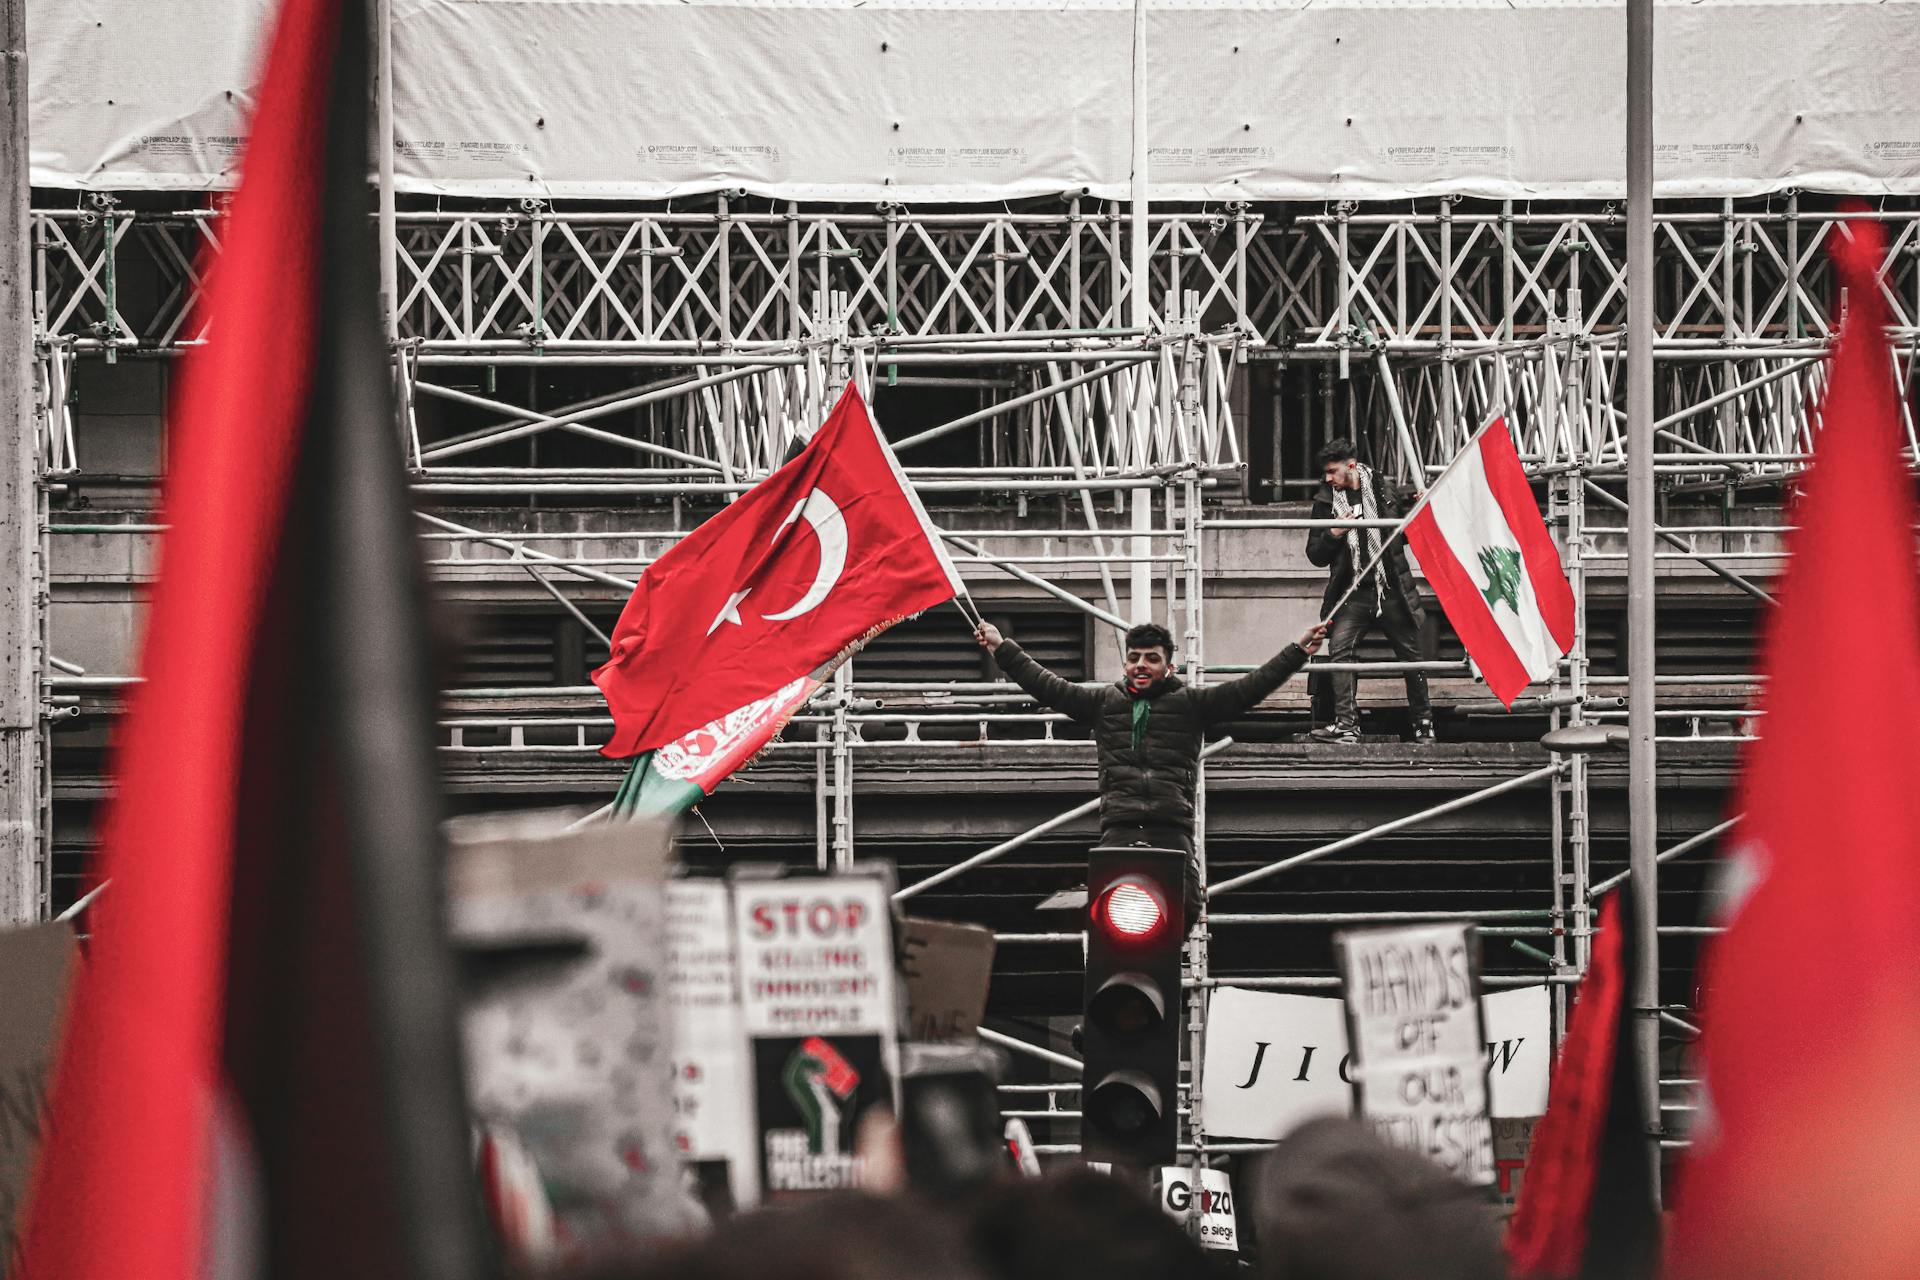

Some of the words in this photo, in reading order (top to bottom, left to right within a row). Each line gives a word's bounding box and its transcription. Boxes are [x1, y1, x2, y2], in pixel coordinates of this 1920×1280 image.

[753, 898, 865, 939] STOP
[1362, 940, 1470, 1015] HANDS
[1235, 1037, 1525, 1089] JIW
[1398, 1066, 1465, 1107] OUR
